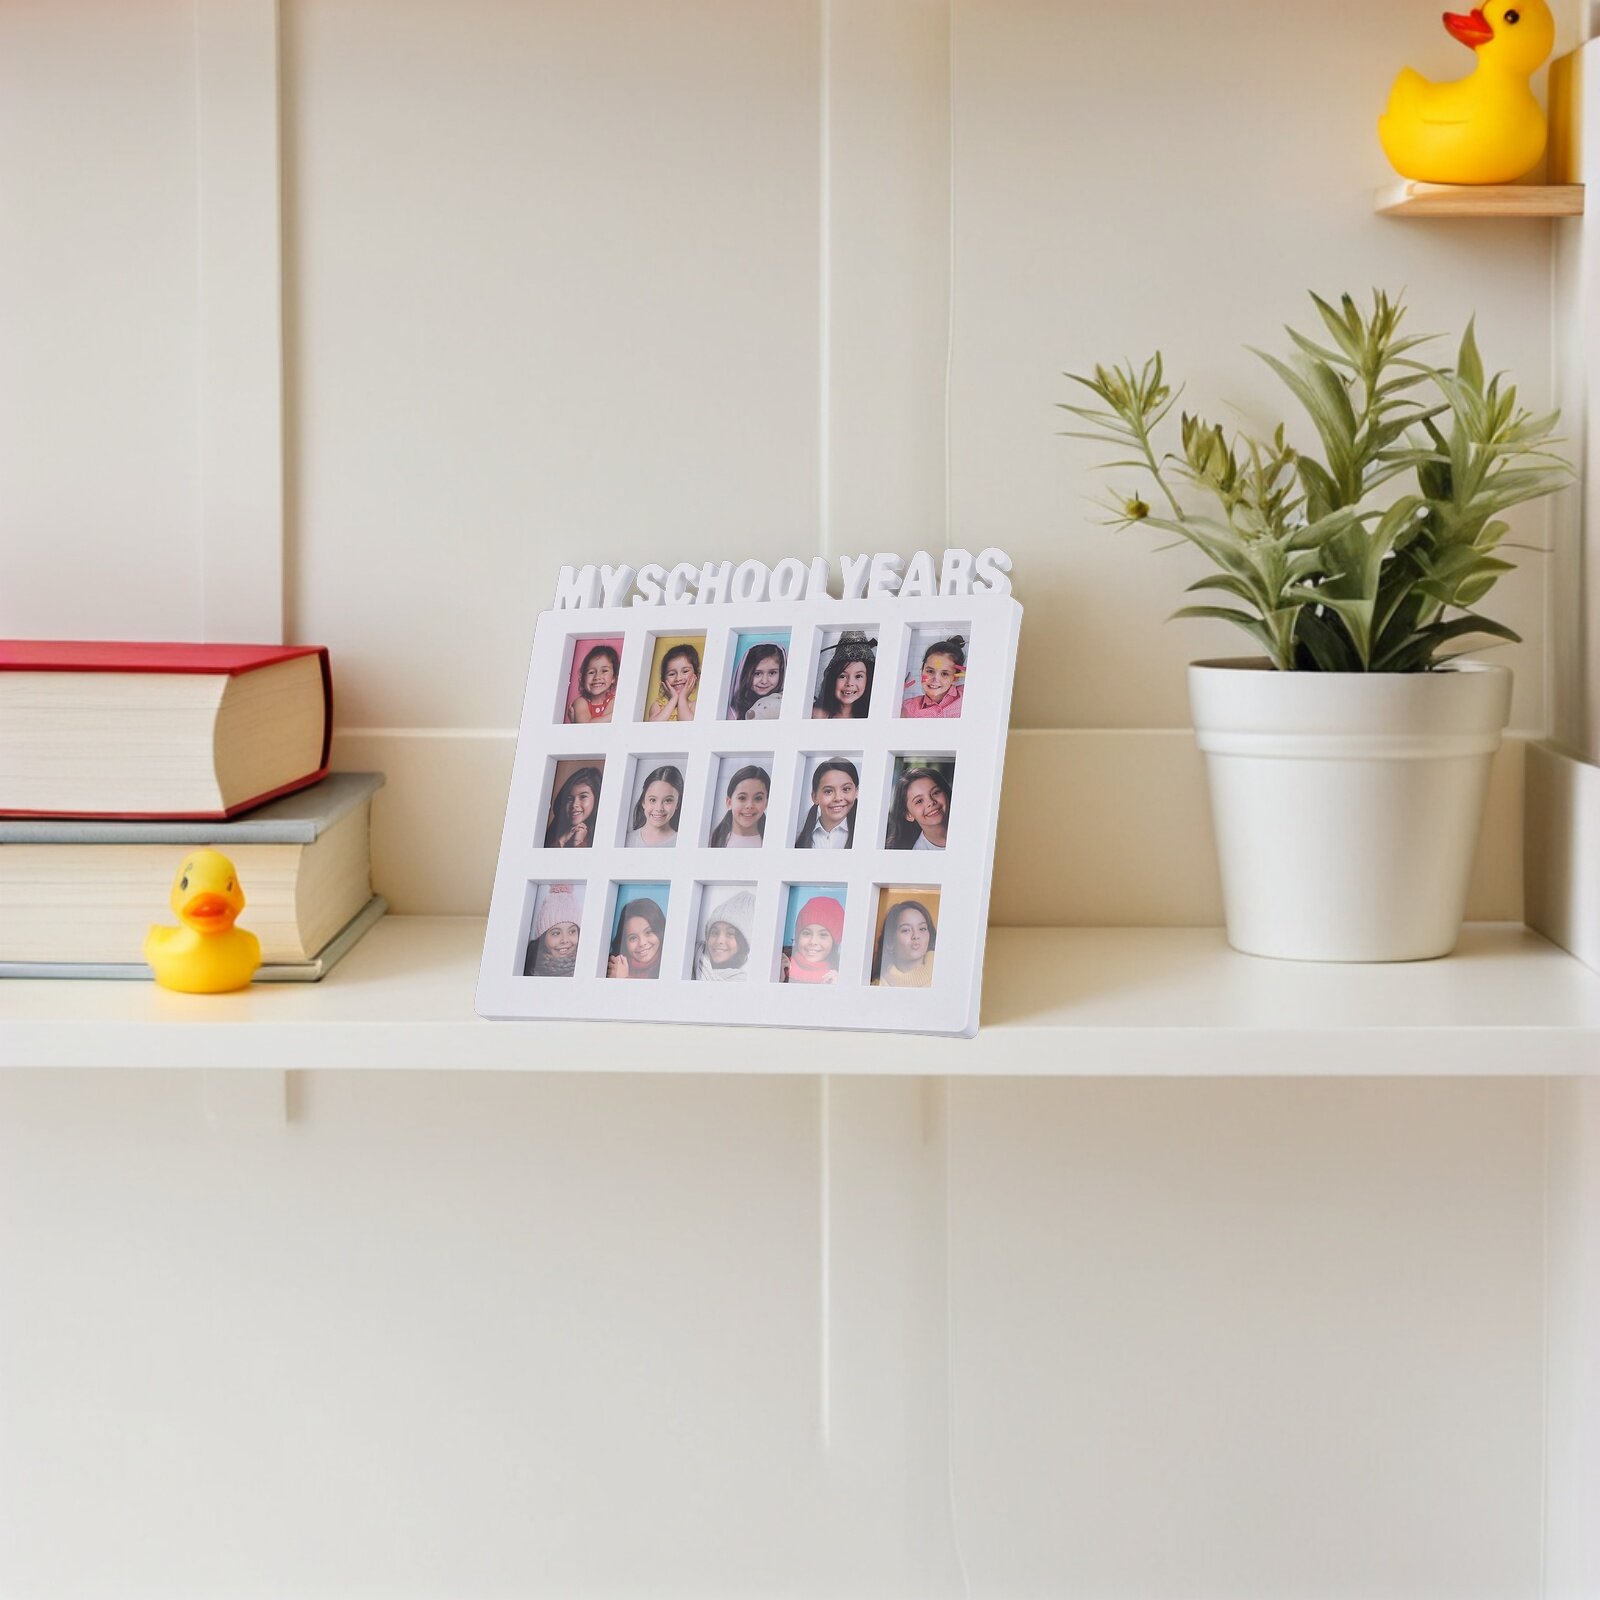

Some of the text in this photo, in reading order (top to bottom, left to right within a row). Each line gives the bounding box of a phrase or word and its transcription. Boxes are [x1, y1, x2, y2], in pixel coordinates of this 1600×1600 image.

[555, 547, 1012, 609] MY SCHOOL YEARS
